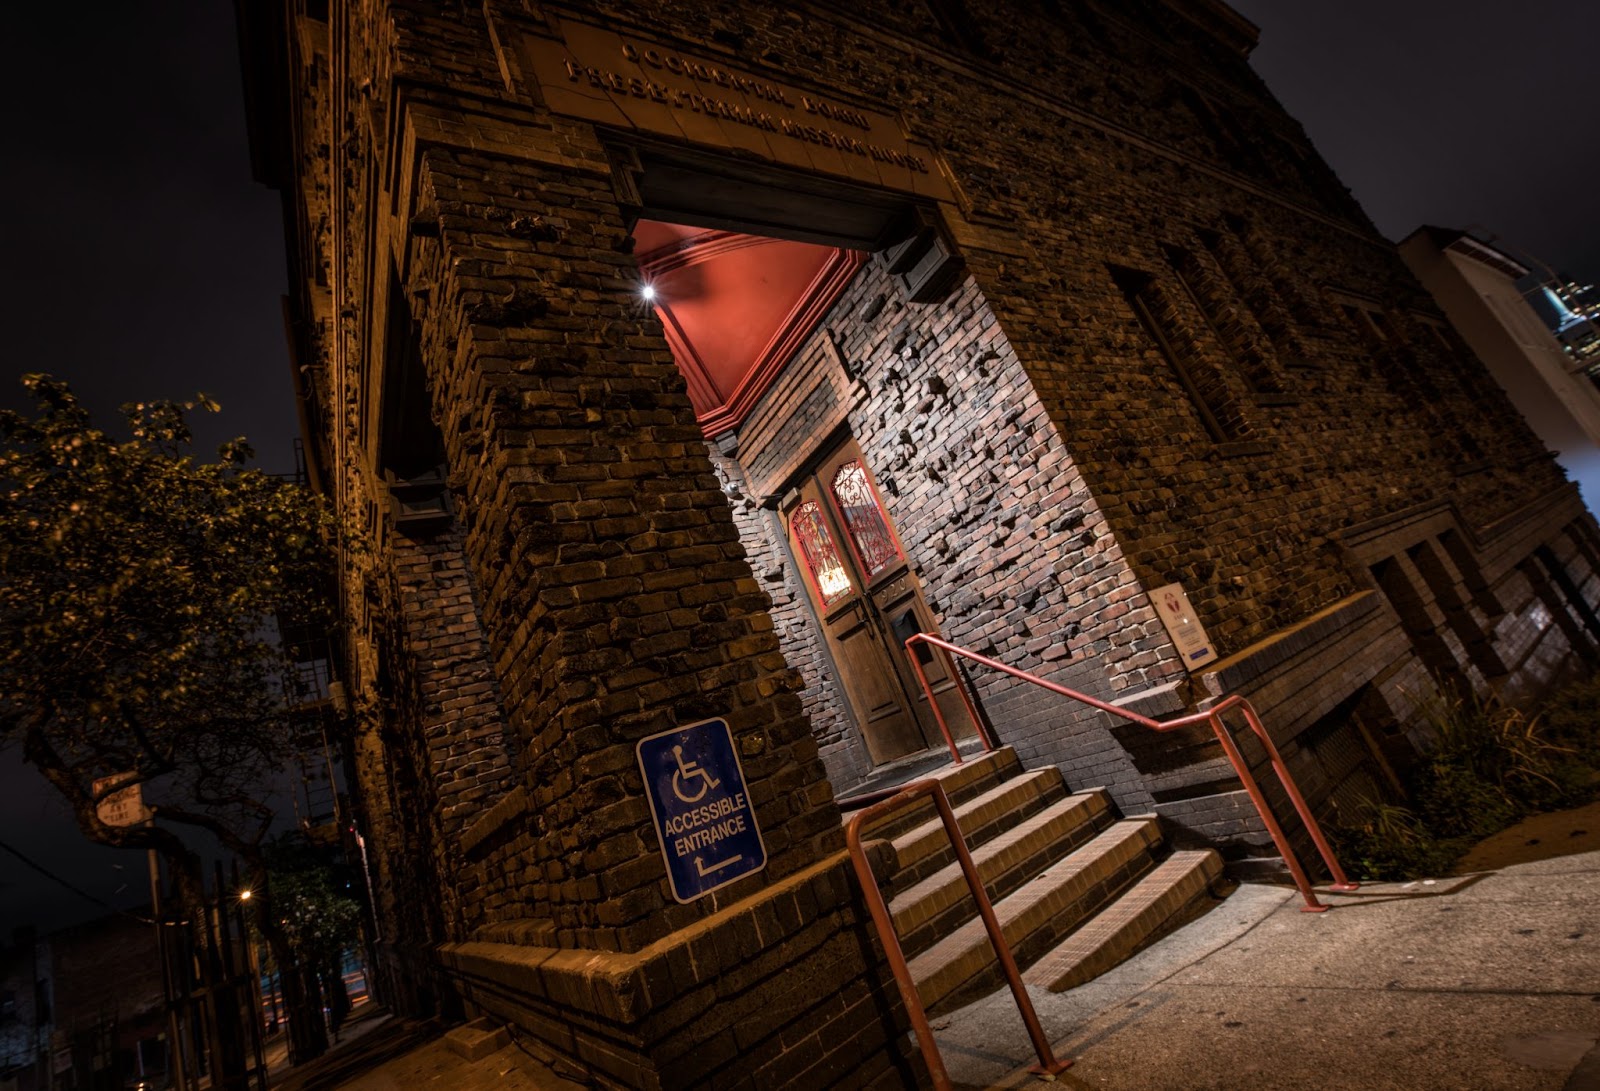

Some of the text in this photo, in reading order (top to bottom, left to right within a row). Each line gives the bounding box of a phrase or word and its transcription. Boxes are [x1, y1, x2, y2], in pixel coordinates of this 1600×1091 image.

[622, 44, 870, 131] OCCIDENTAL BOARD
[563, 58, 928, 174] PRESBYTERIAN MISSION HOUSE
[880, 578, 906, 603] 920
[665, 793, 746, 837] ACCESSIBLE
[674, 816, 747, 857] ENTRANCE
